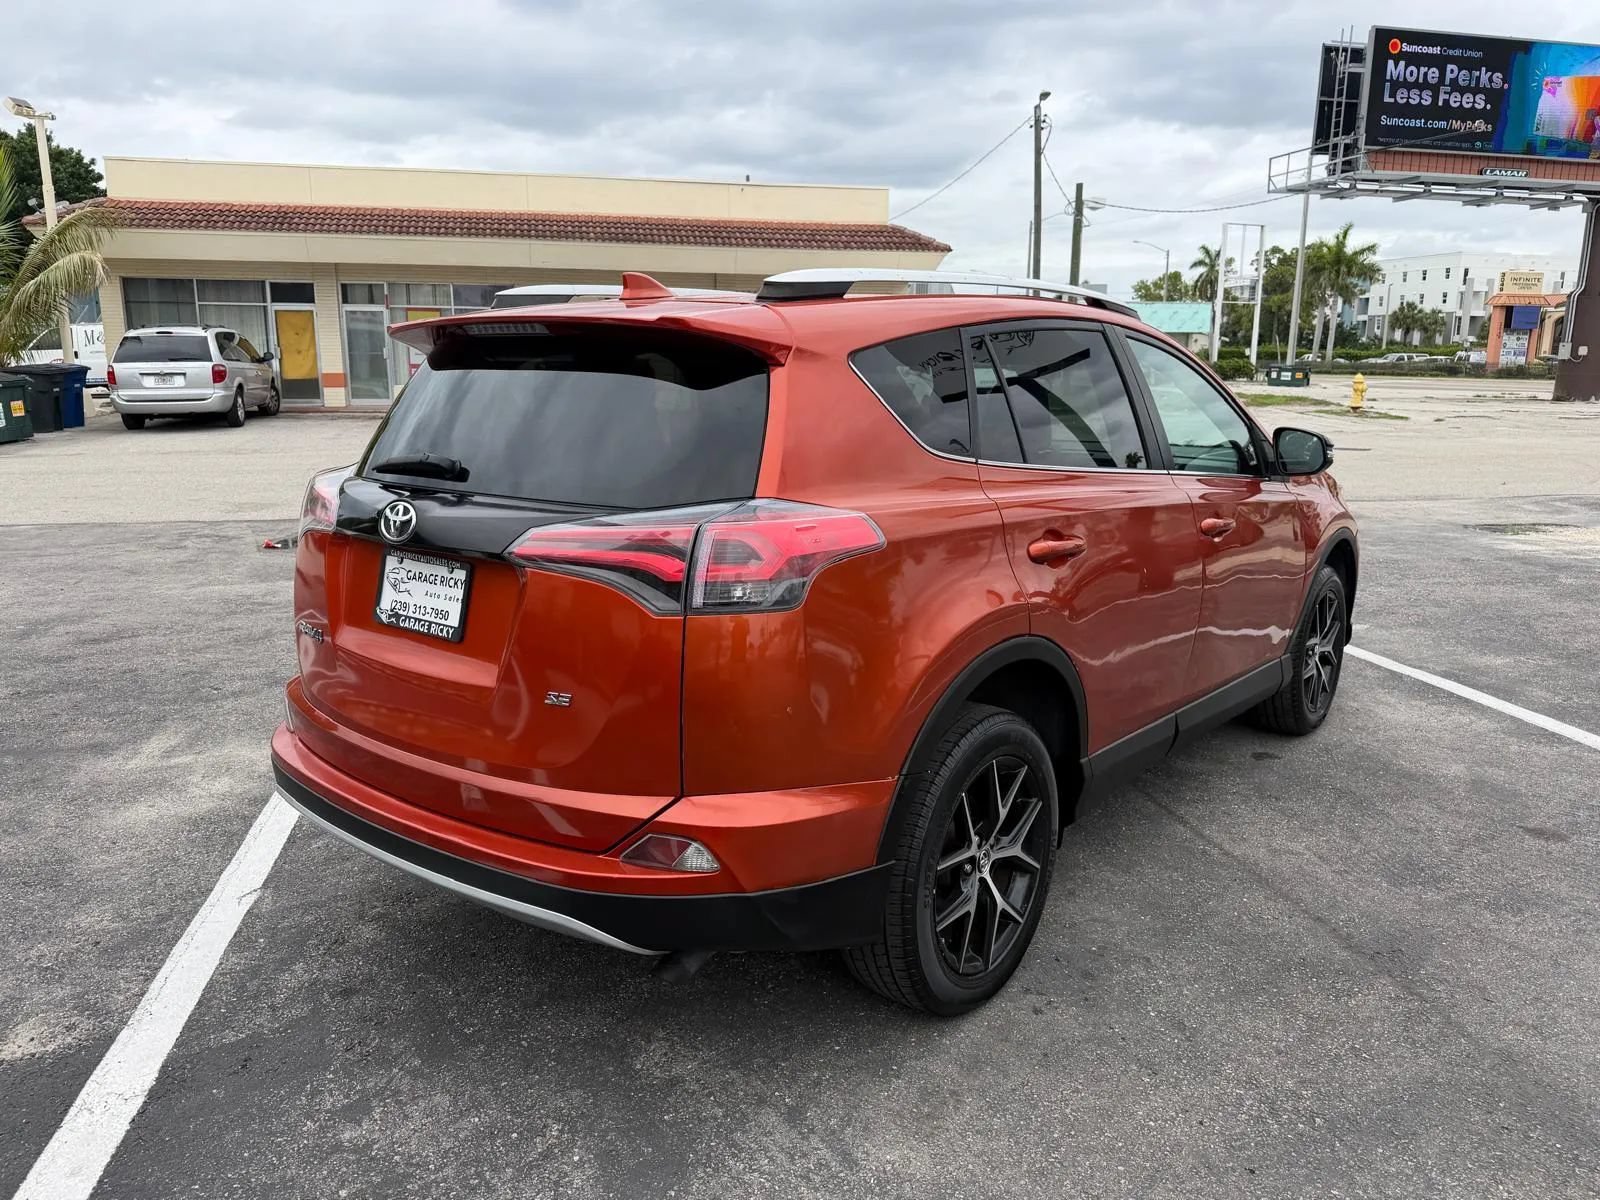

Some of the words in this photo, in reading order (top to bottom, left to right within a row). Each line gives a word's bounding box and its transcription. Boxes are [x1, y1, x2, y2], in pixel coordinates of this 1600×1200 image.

[1401, 43, 1441, 54] Suncoast
[1441, 47, 1462, 57] Credit
[1463, 48, 1483, 58] Union
[1386, 59, 1439, 84] More
[1445, 64, 1509, 89] Perks.
[1383, 82, 1432, 105] Less
[1438, 86, 1491, 110] Fees.
[1380, 115, 1493, 132] Suncoast.com/MyPks
[1485, 169, 1528, 177] LAMAR
[406, 570, 439, 585] GARAGE
[439, 574, 466, 591] RICKY
[425, 590, 440, 600] Auto
[390, 599, 410, 615] (239)
[411, 603, 450, 621] 313-7950
[399, 615, 429, 633] GARAGE
[430, 622, 454, 639] RICKY
[544, 691, 572, 706] SE
